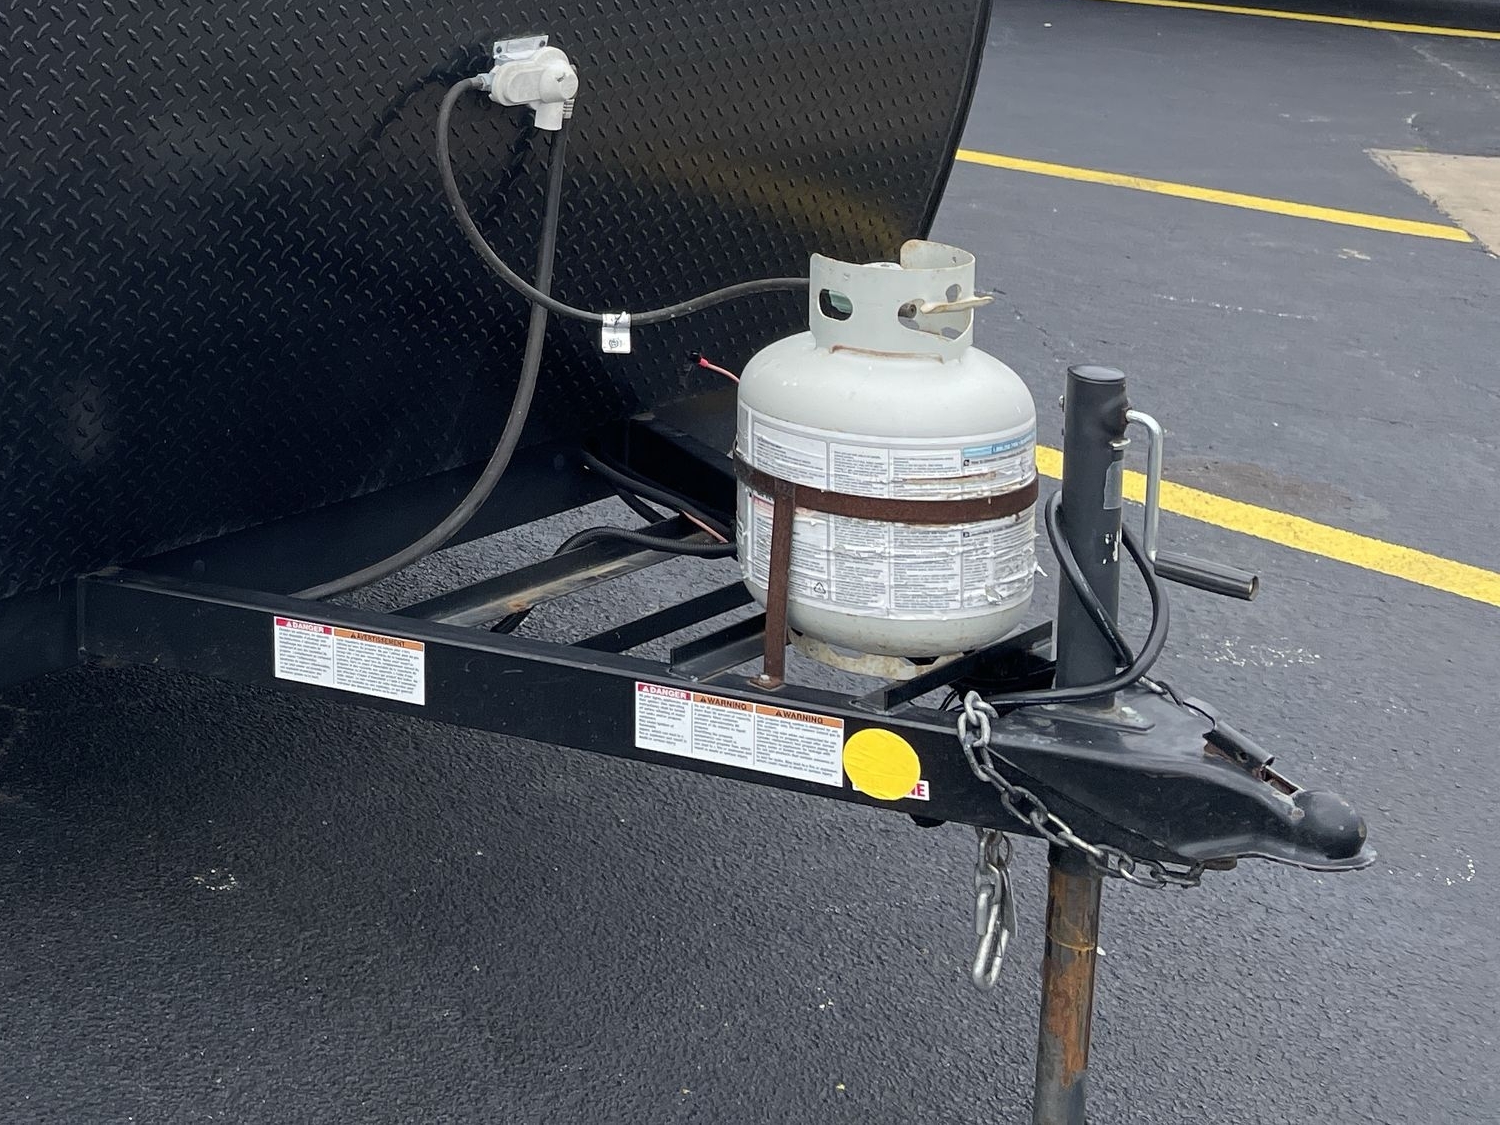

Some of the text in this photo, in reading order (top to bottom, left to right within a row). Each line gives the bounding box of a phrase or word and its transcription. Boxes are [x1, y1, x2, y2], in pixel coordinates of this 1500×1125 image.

[293, 621, 324, 633] DANGER
[357, 633, 405, 648] AVERTISSEMENT
[650, 688, 687, 699] DANGER
[707, 697, 747, 710] WARNING
[783, 711, 824, 725] WARNING
